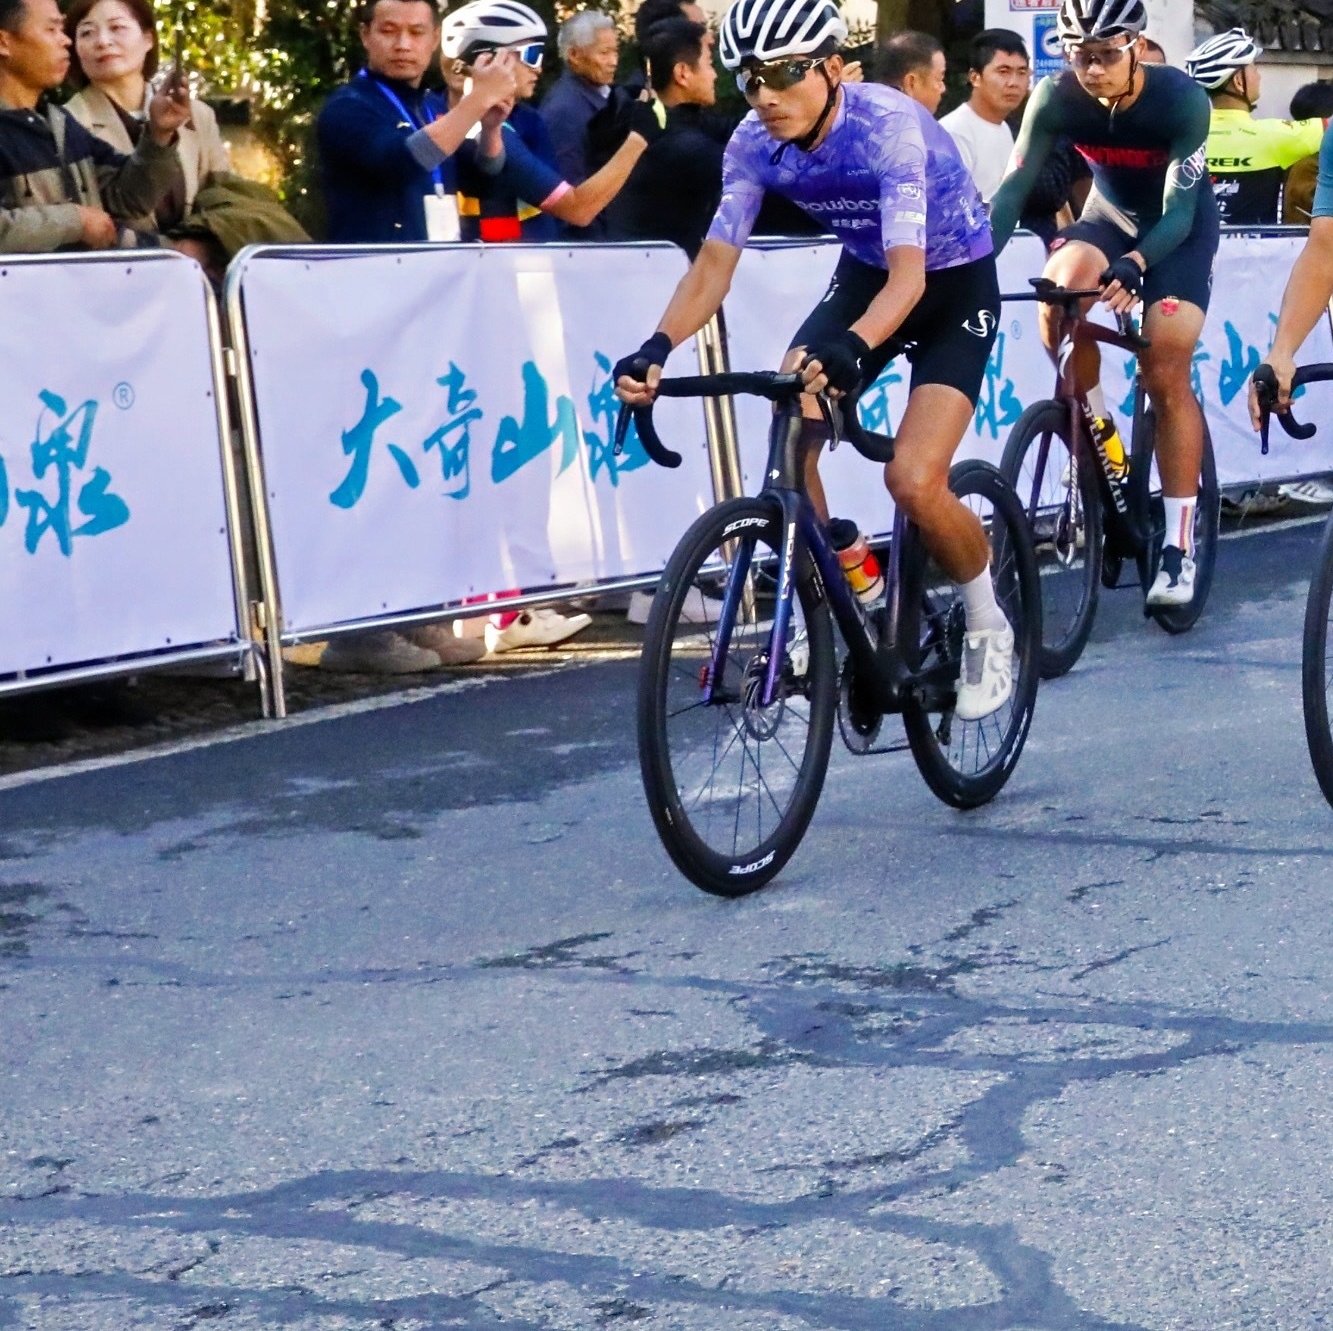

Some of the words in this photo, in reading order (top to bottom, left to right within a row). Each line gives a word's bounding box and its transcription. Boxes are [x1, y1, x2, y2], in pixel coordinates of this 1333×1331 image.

[1205, 157, 1252, 167] REK
[722, 518, 770, 538] SCOPE
[729, 851, 775, 873] SCOPE
